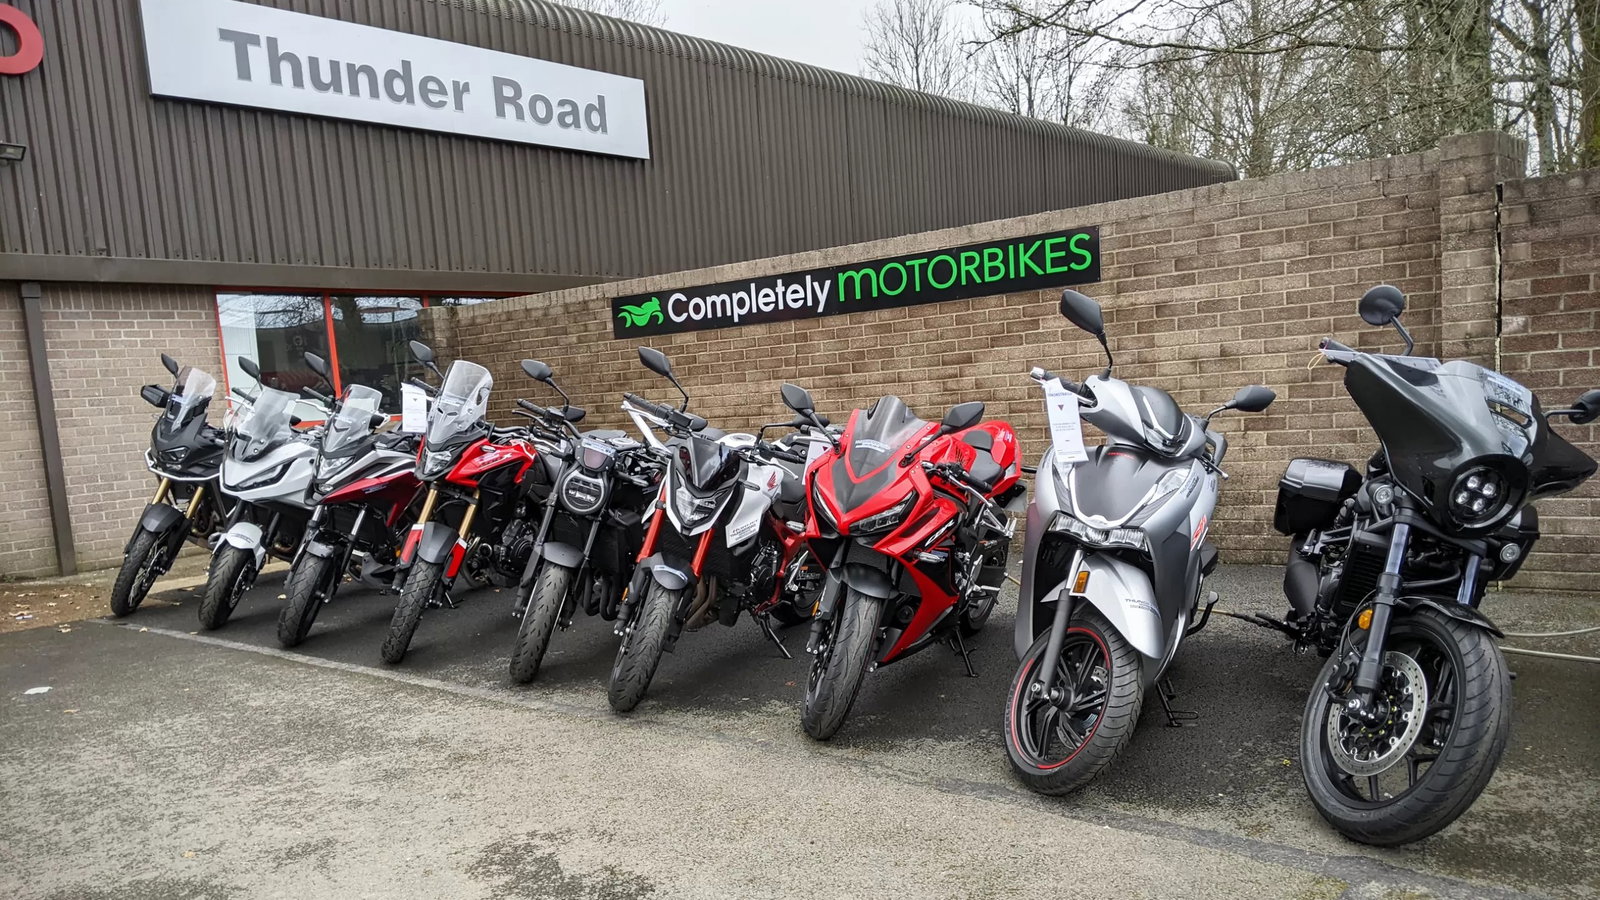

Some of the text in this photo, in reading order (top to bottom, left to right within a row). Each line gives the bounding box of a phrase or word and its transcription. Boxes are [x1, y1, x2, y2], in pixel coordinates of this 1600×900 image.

[218, 27, 608, 134] Thunder Road
[667, 274, 832, 323] Completely
